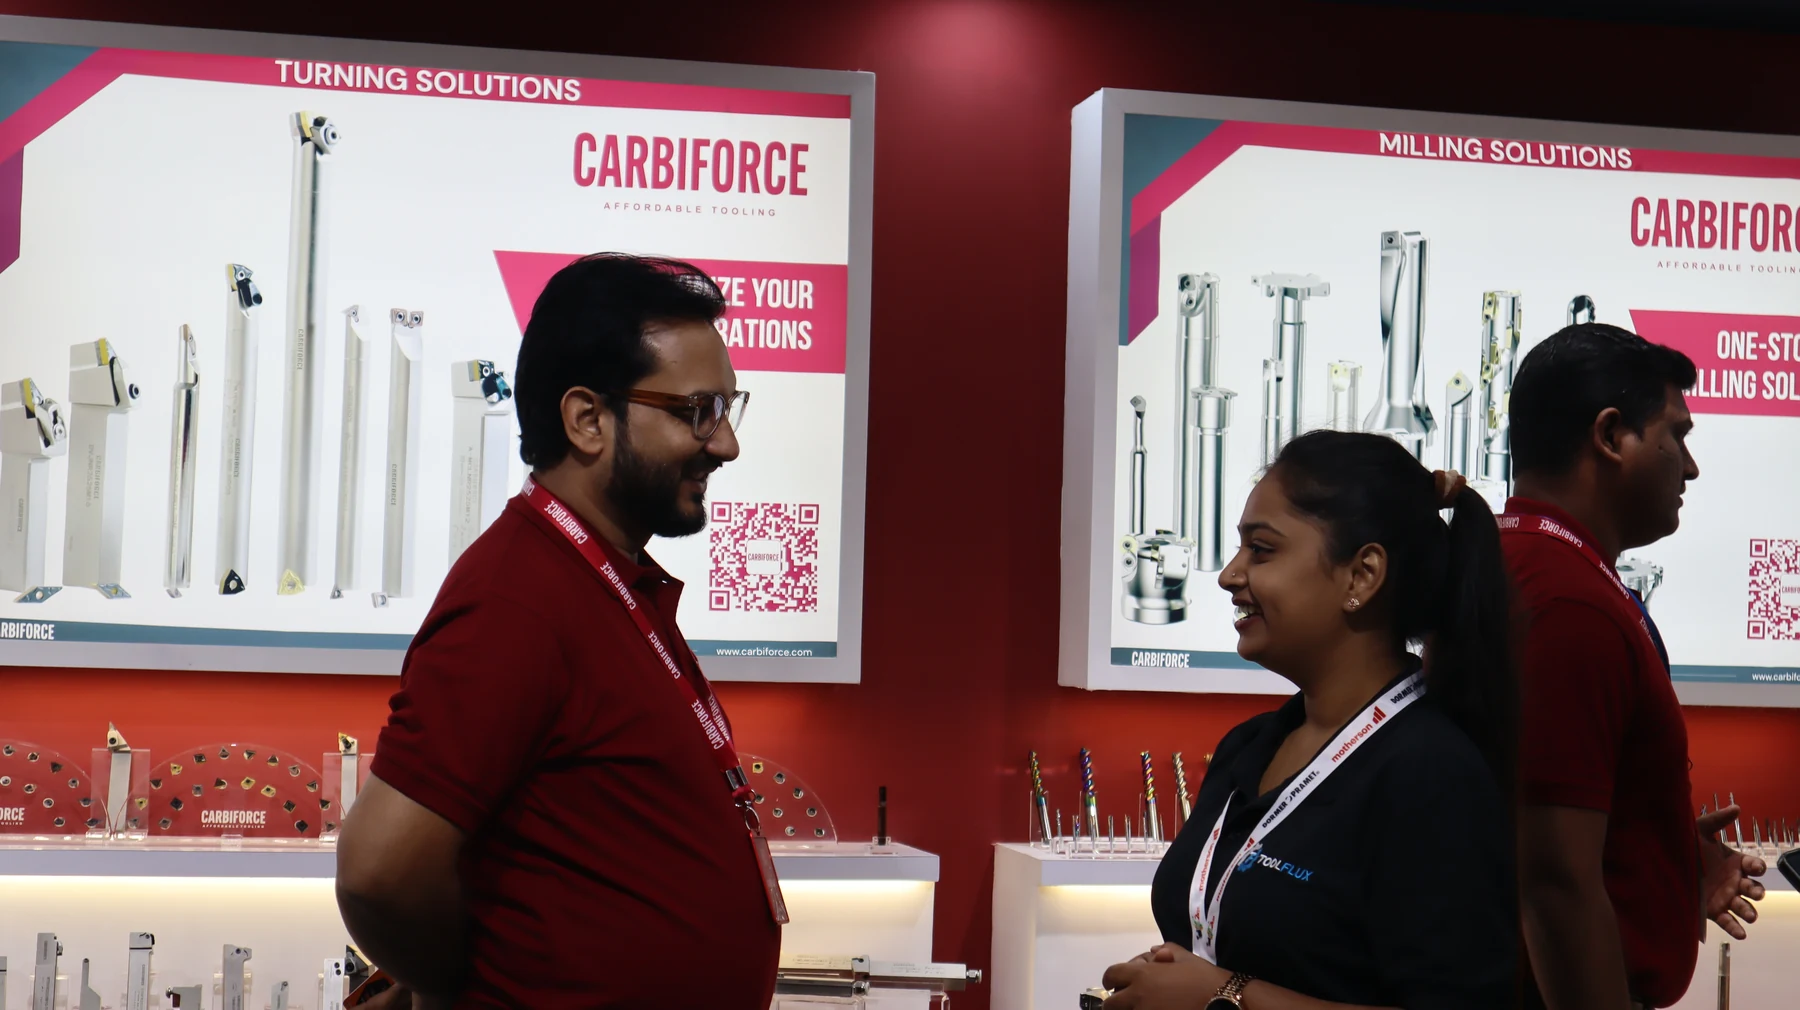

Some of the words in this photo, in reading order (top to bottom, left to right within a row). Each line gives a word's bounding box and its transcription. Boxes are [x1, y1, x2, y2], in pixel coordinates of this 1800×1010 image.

[275, 59, 408, 91] TURNING
[415, 69, 582, 102] SOLUTIONS
[573, 132, 809, 196] CARBIFORCE
[1379, 132, 1484, 160] MILLING
[1490, 140, 1633, 169] SOLUTIONS
[603, 201, 702, 214] AFFORDABLE
[712, 206, 777, 217] TOOLING
[1631, 196, 1800, 253] CARBIFOR
[1657, 261, 1742, 272] AFFORDABLE
[1751, 265, 1800, 274] TOOLIN
[711, 276, 746, 307] ZE
[752, 278, 814, 310] YOUR
[544, 500, 588, 545] CARBIFORCE
[1538, 519, 1583, 548] CARBIFORCE
[747, 553, 780, 562] CARBIFORCE
[600, 561, 637, 610] CARBIFORCE
[1, 621, 55, 640] RBIFORCE
[648, 630, 681, 680] CARBIFORCE
[716, 646, 813, 658] www.carbiforce.com
[1131, 651, 1190, 668] CARBIFORCE
[691, 699, 725, 750] CARBIFORCE
[1331, 723, 1373, 763] motherson
[201, 810, 266, 824] CARBIFORCE
[1262, 801, 1288, 829] DORMER
[1290, 771, 1318, 798] PRAMET
[1257, 853, 1314, 881] TOOLFLUX
